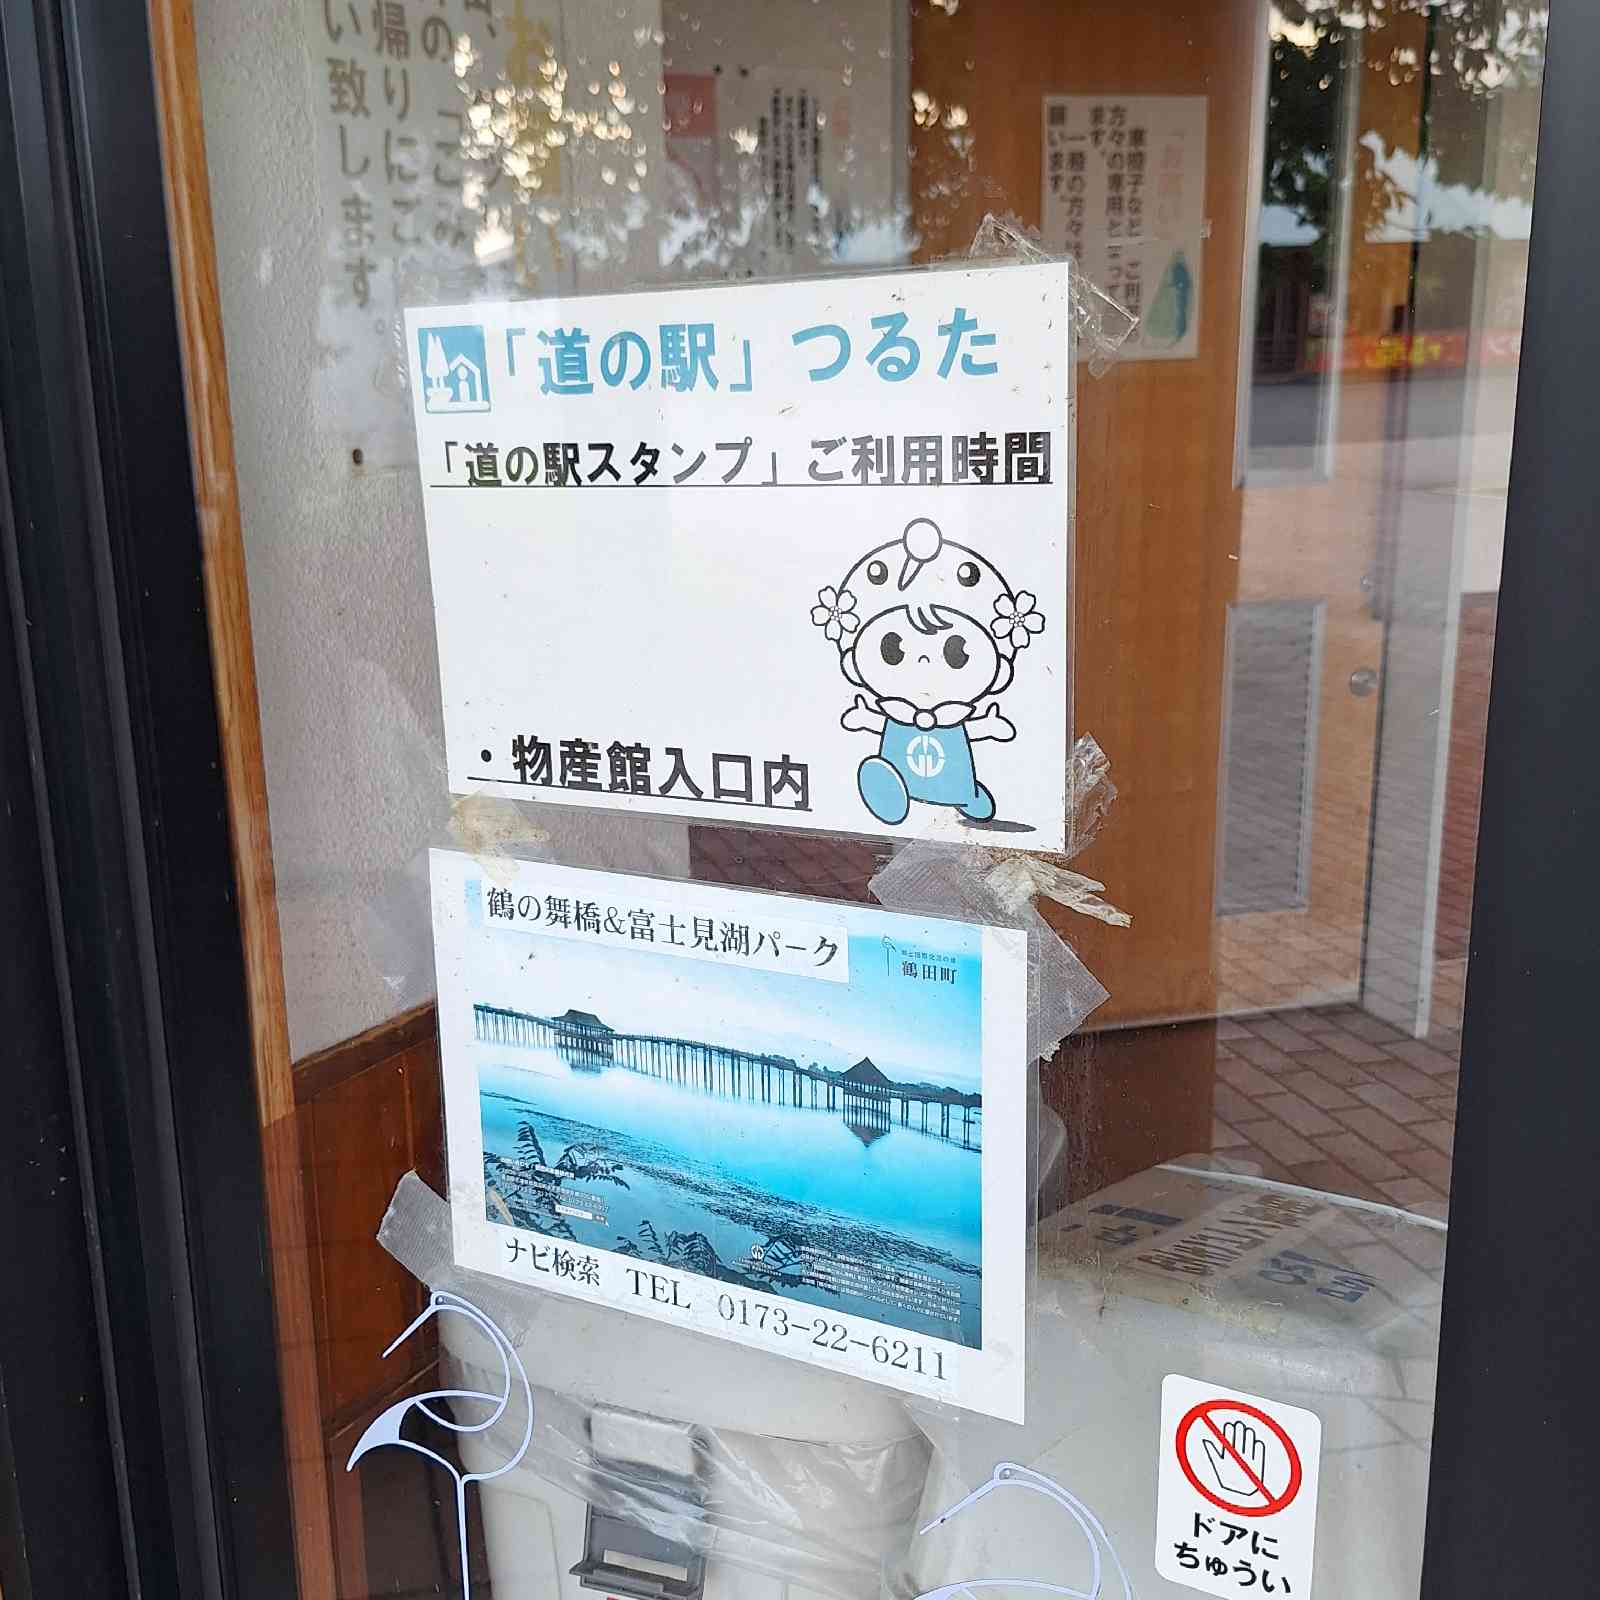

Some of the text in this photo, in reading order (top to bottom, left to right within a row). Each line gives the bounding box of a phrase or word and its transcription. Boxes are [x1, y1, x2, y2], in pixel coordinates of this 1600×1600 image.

[505, 306, 1000, 395] 「道の駅」 つるた
[808, 430, 1053, 485] ご利用時間
[902, 960, 957, 985] 鶴田町
[504, 1236, 948, 1382] ナビ検索 TEL 0173-22-6211
[1193, 1511, 1281, 1561] ドアに
[1173, 1541, 1293, 1595] ちゅうい
